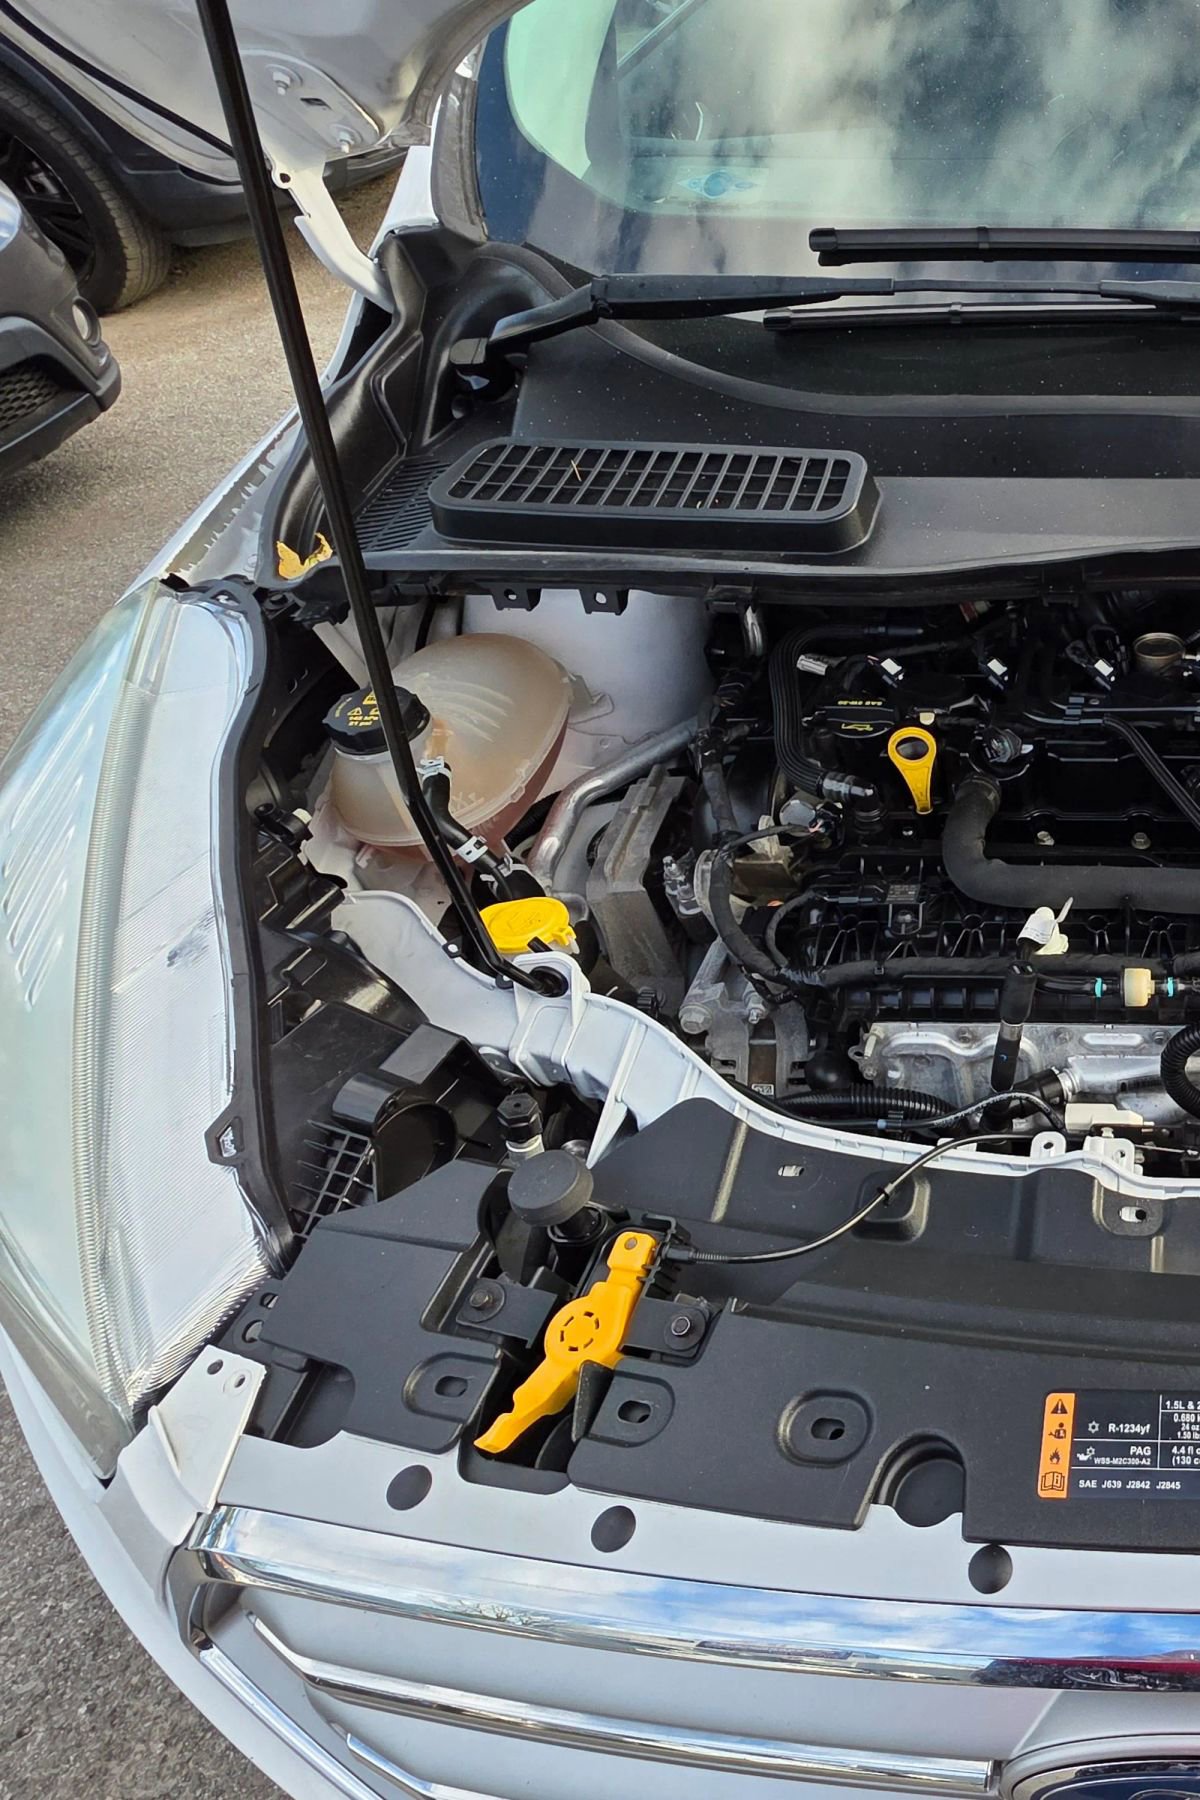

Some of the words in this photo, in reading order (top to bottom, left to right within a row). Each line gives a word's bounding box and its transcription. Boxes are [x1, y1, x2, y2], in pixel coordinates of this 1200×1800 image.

[1165, 1400, 1185, 1410] 1.5L
[1187, 1400, 1195, 1410] &
[1173, 1413, 1196, 1423] 0.680
[1108, 1423, 1151, 1436] R-1234yf
[1180, 1423, 1190, 1431] 24
[1177, 1431, 1192, 1440] 1.50
[1129, 1445, 1152, 1456] PAG
[1171, 1445, 1186, 1455] 4.4
[1187, 1445, 1194, 1455] fl
[1171, 1455, 1192, 1466] (130
[1078, 1479, 1098, 1488] SAE
[1101, 1479, 1122, 1489] J639
[1125, 1480, 1151, 1489] J2842
[1155, 1481, 1182, 1490] J2845
